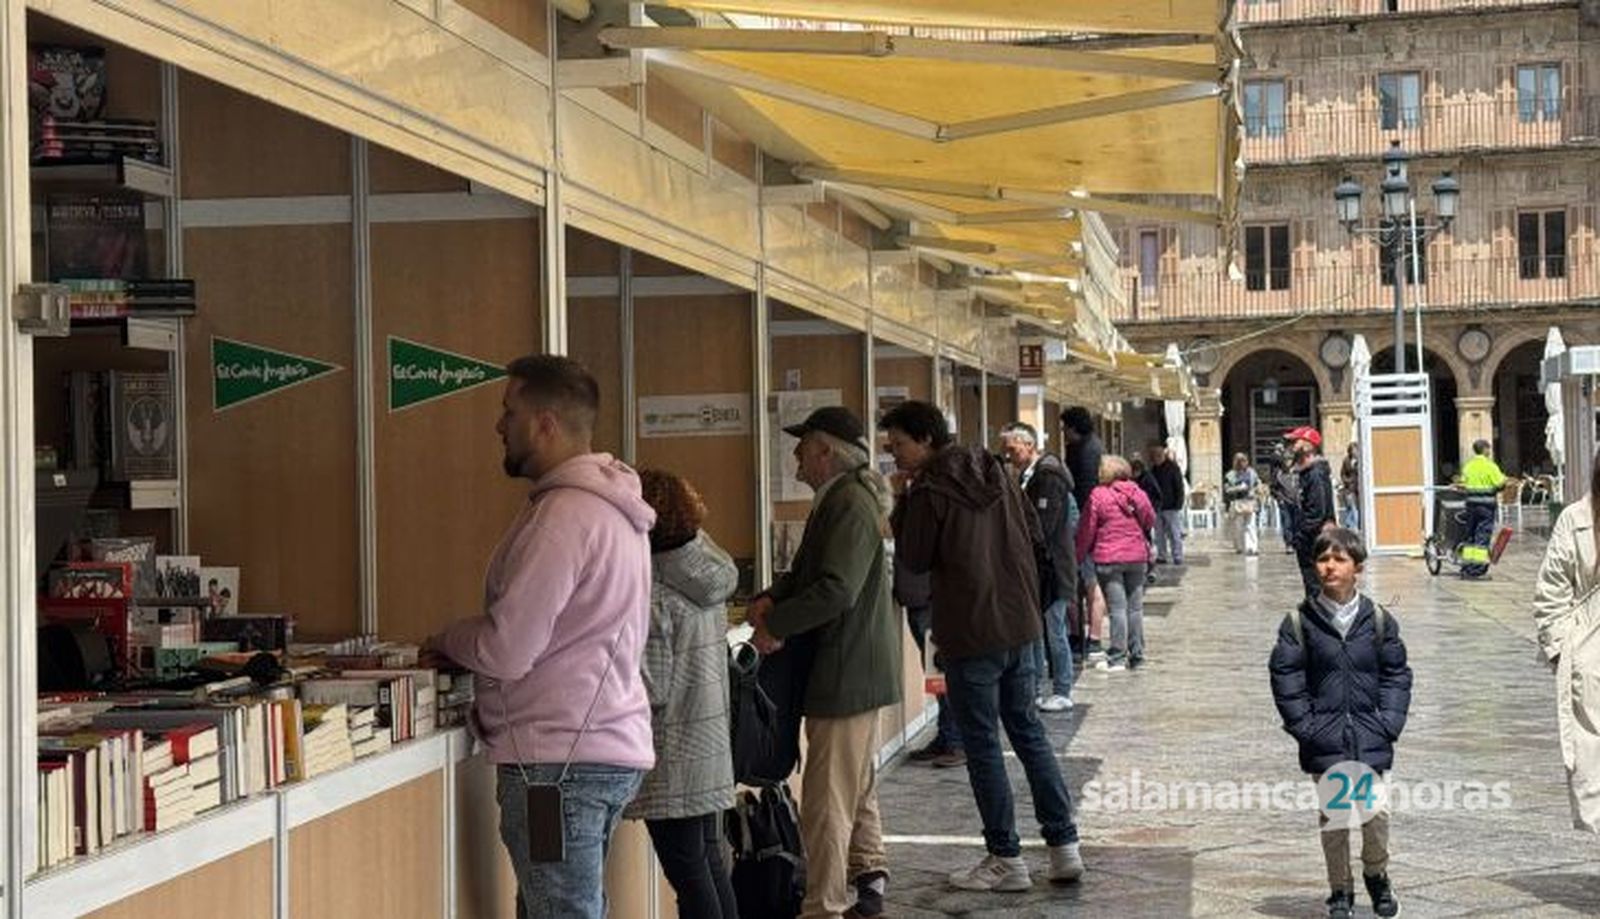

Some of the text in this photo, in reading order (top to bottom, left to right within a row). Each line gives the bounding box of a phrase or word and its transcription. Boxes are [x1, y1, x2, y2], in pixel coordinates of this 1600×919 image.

[216, 363, 229, 379] El
[393, 364, 407, 379] El
[408, 364, 439, 380] Corte
